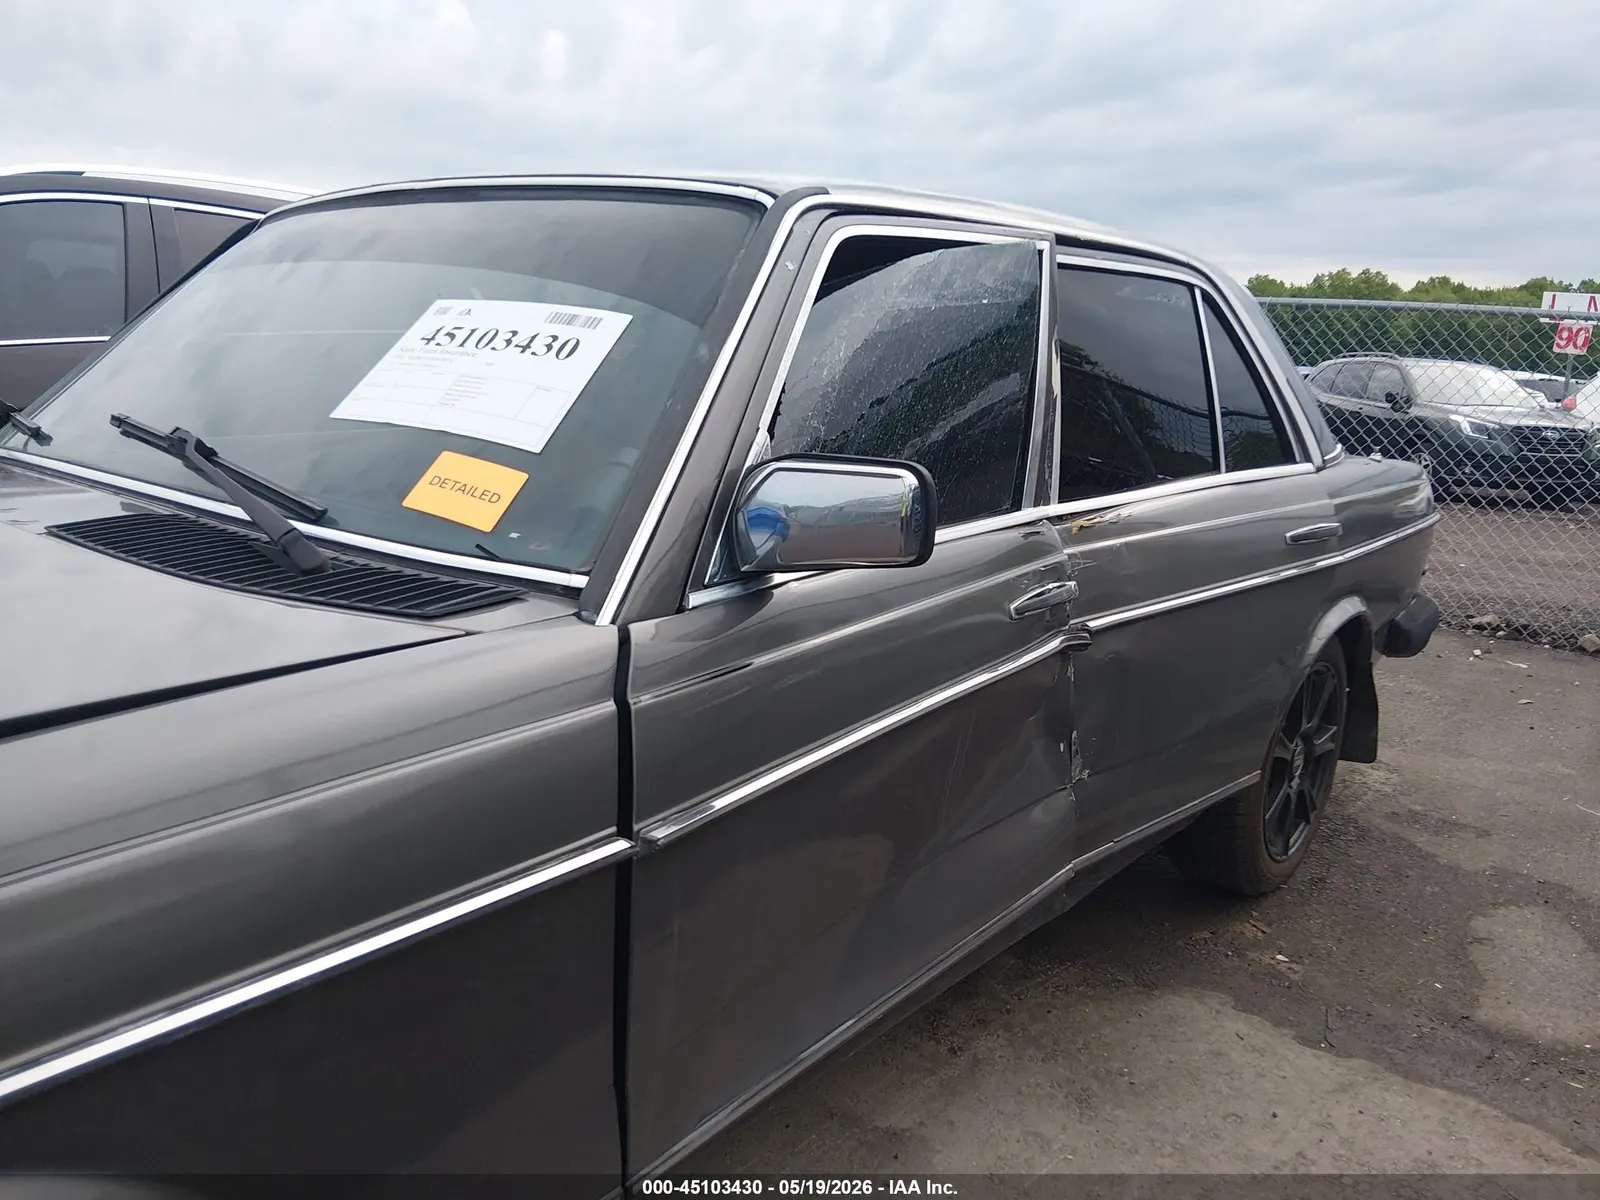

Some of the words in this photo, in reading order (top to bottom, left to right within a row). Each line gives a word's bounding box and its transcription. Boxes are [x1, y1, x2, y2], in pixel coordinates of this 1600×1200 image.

[420, 325, 580, 361] 45103430
[1556, 327, 1590, 350] 90
[428, 475, 501, 504] DETAILED
